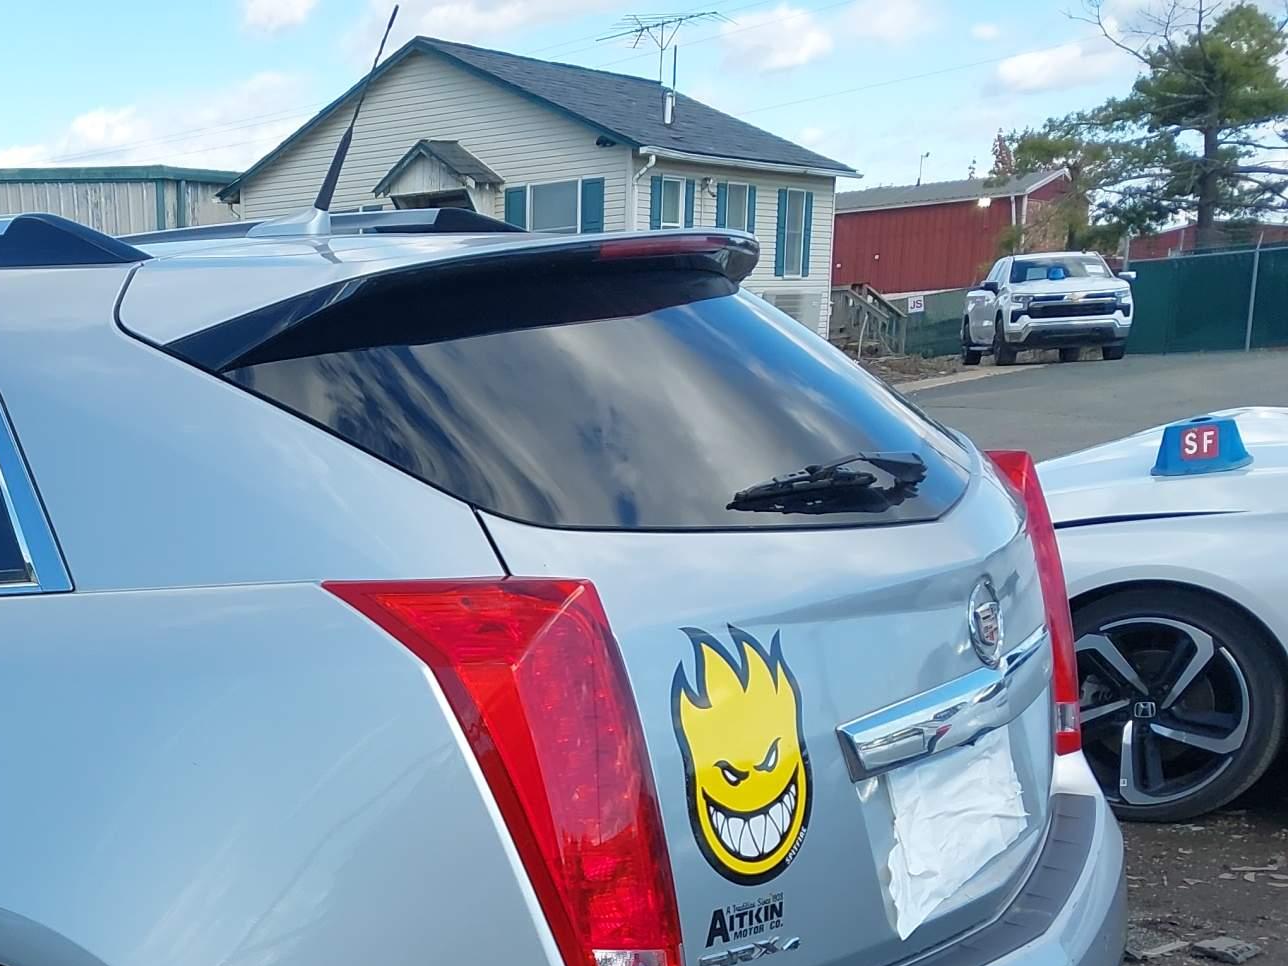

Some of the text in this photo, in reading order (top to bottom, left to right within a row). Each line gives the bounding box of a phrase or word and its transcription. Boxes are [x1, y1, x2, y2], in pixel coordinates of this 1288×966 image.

[910, 299, 923, 309] JS
[1184, 430, 1215, 454] SF
[705, 901, 783, 948] AITKIN
[733, 919, 783, 940] MOTOR CO.
